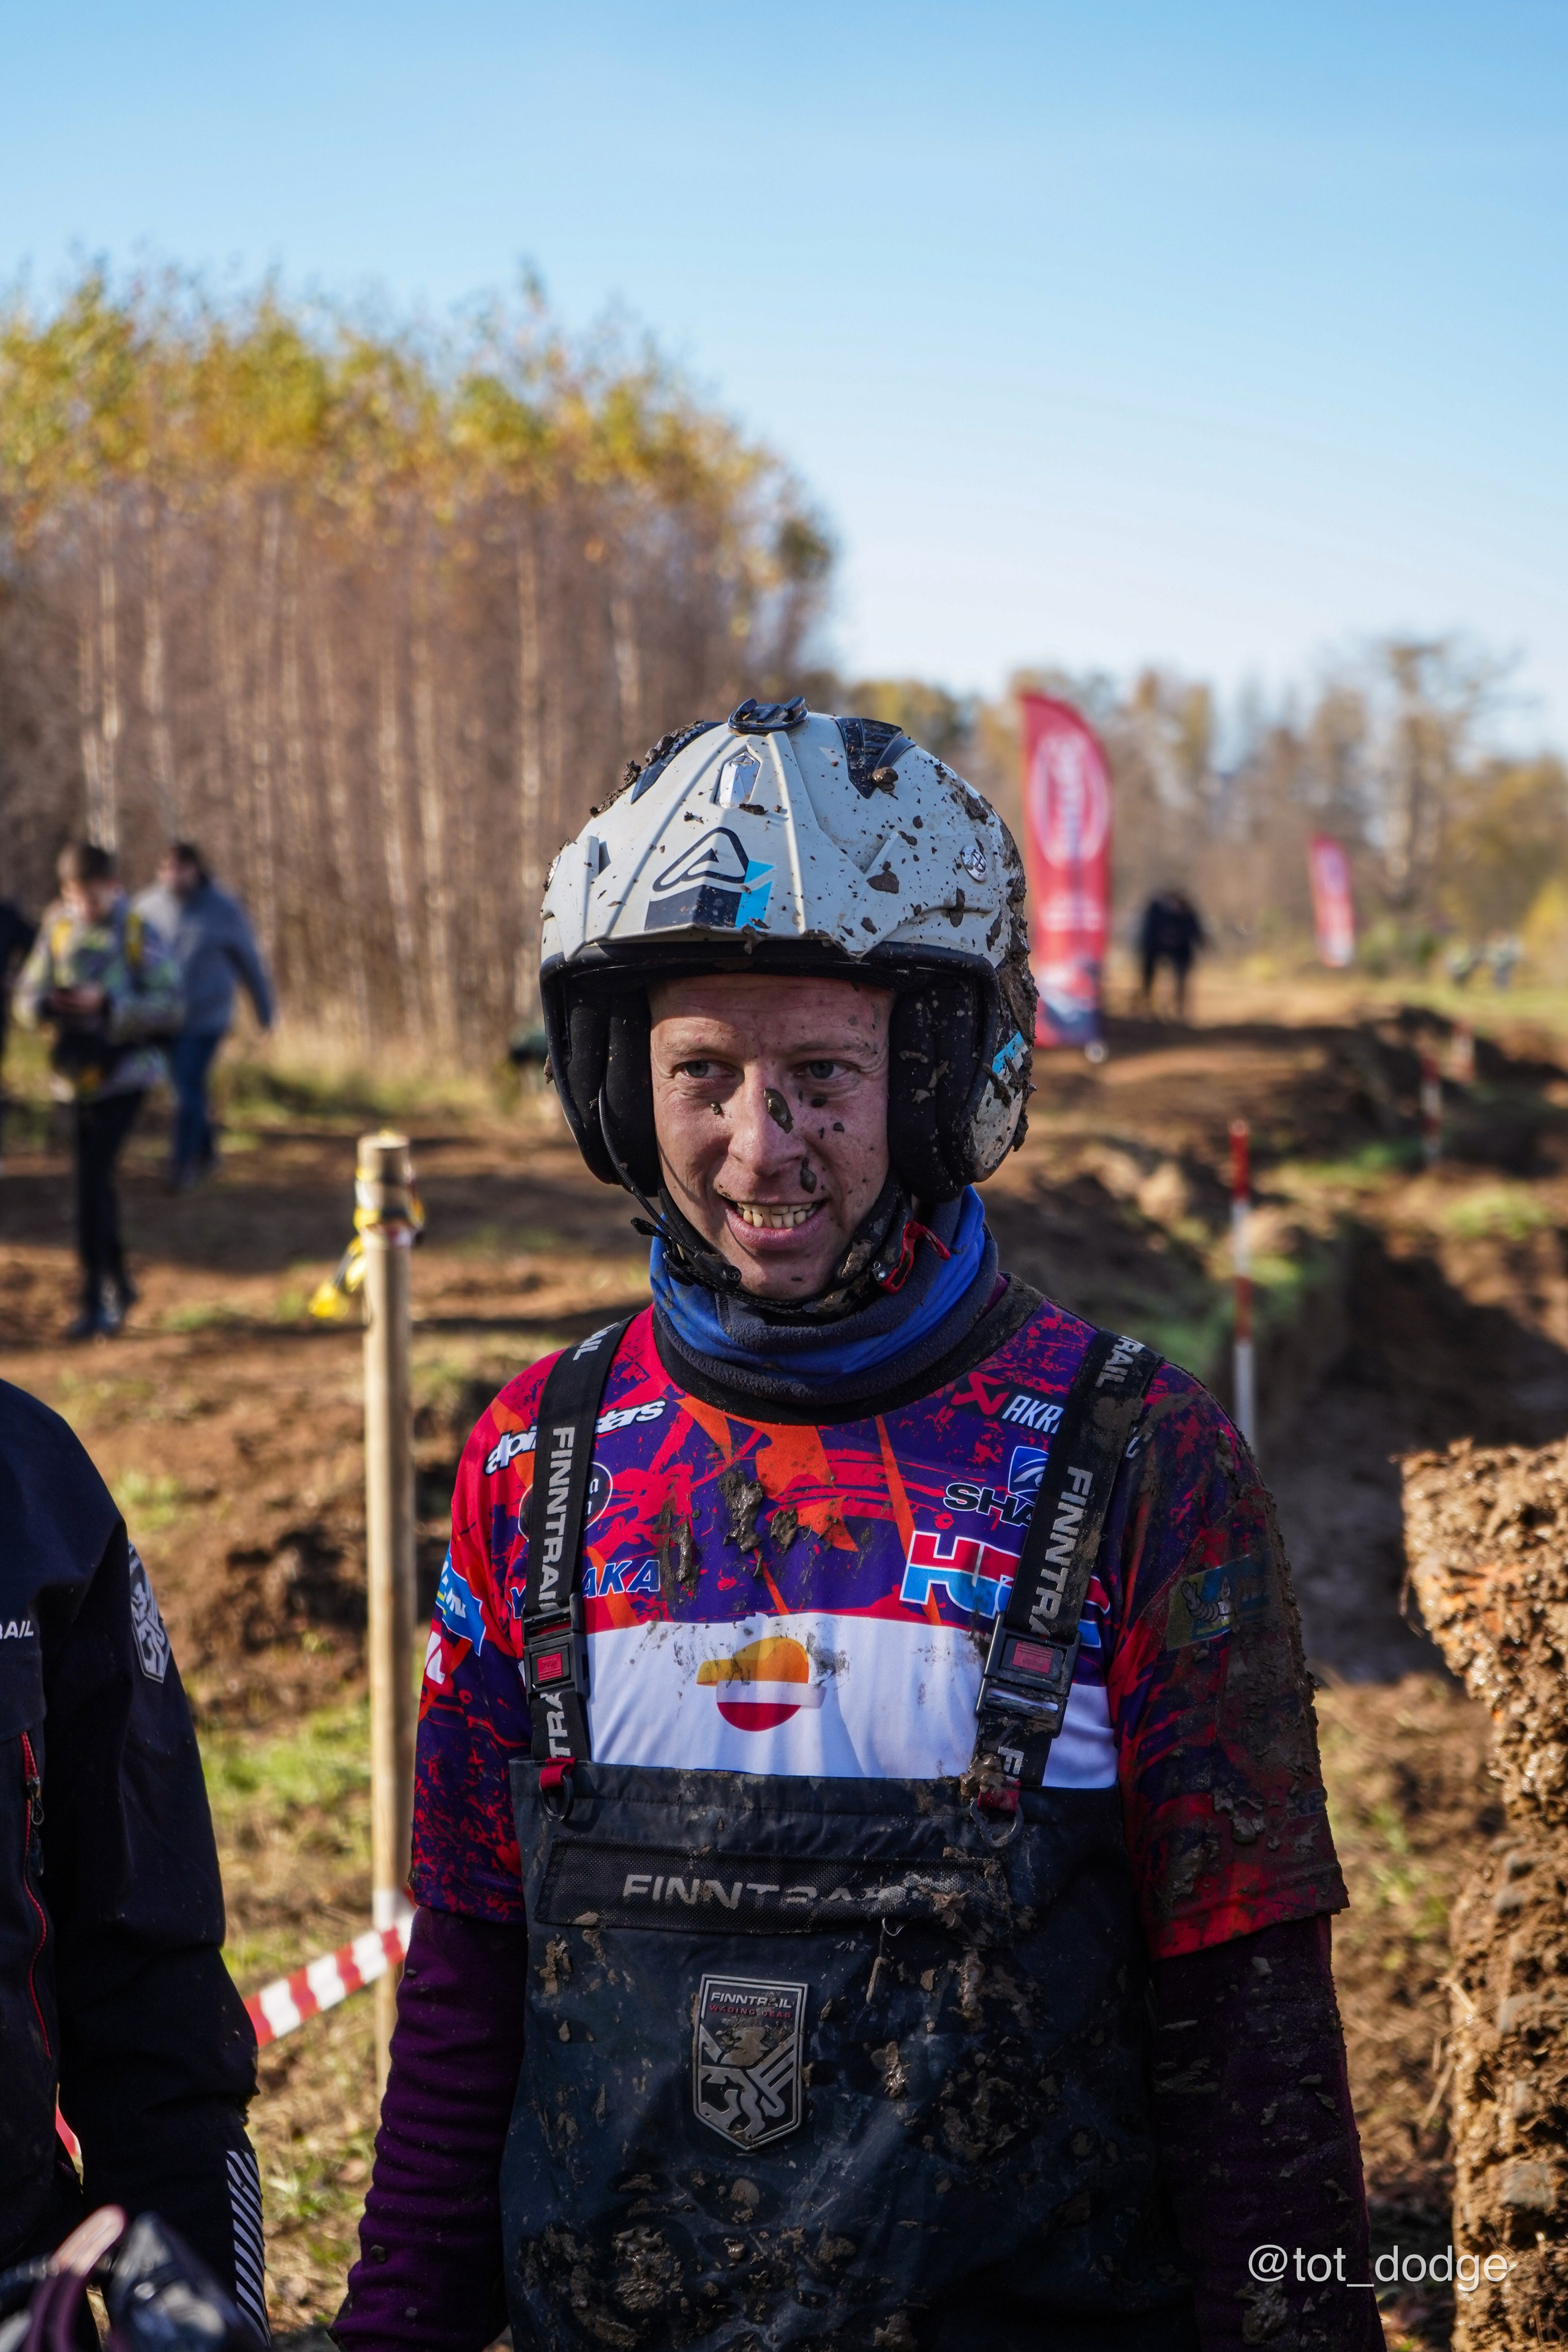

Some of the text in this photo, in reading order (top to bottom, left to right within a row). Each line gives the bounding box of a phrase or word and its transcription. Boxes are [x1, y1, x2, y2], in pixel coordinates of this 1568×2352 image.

[1095, 1336, 1146, 1388] RAIL
[997, 1746, 1025, 1782] F
[709, 2005, 791, 2019] WADING GEAR
